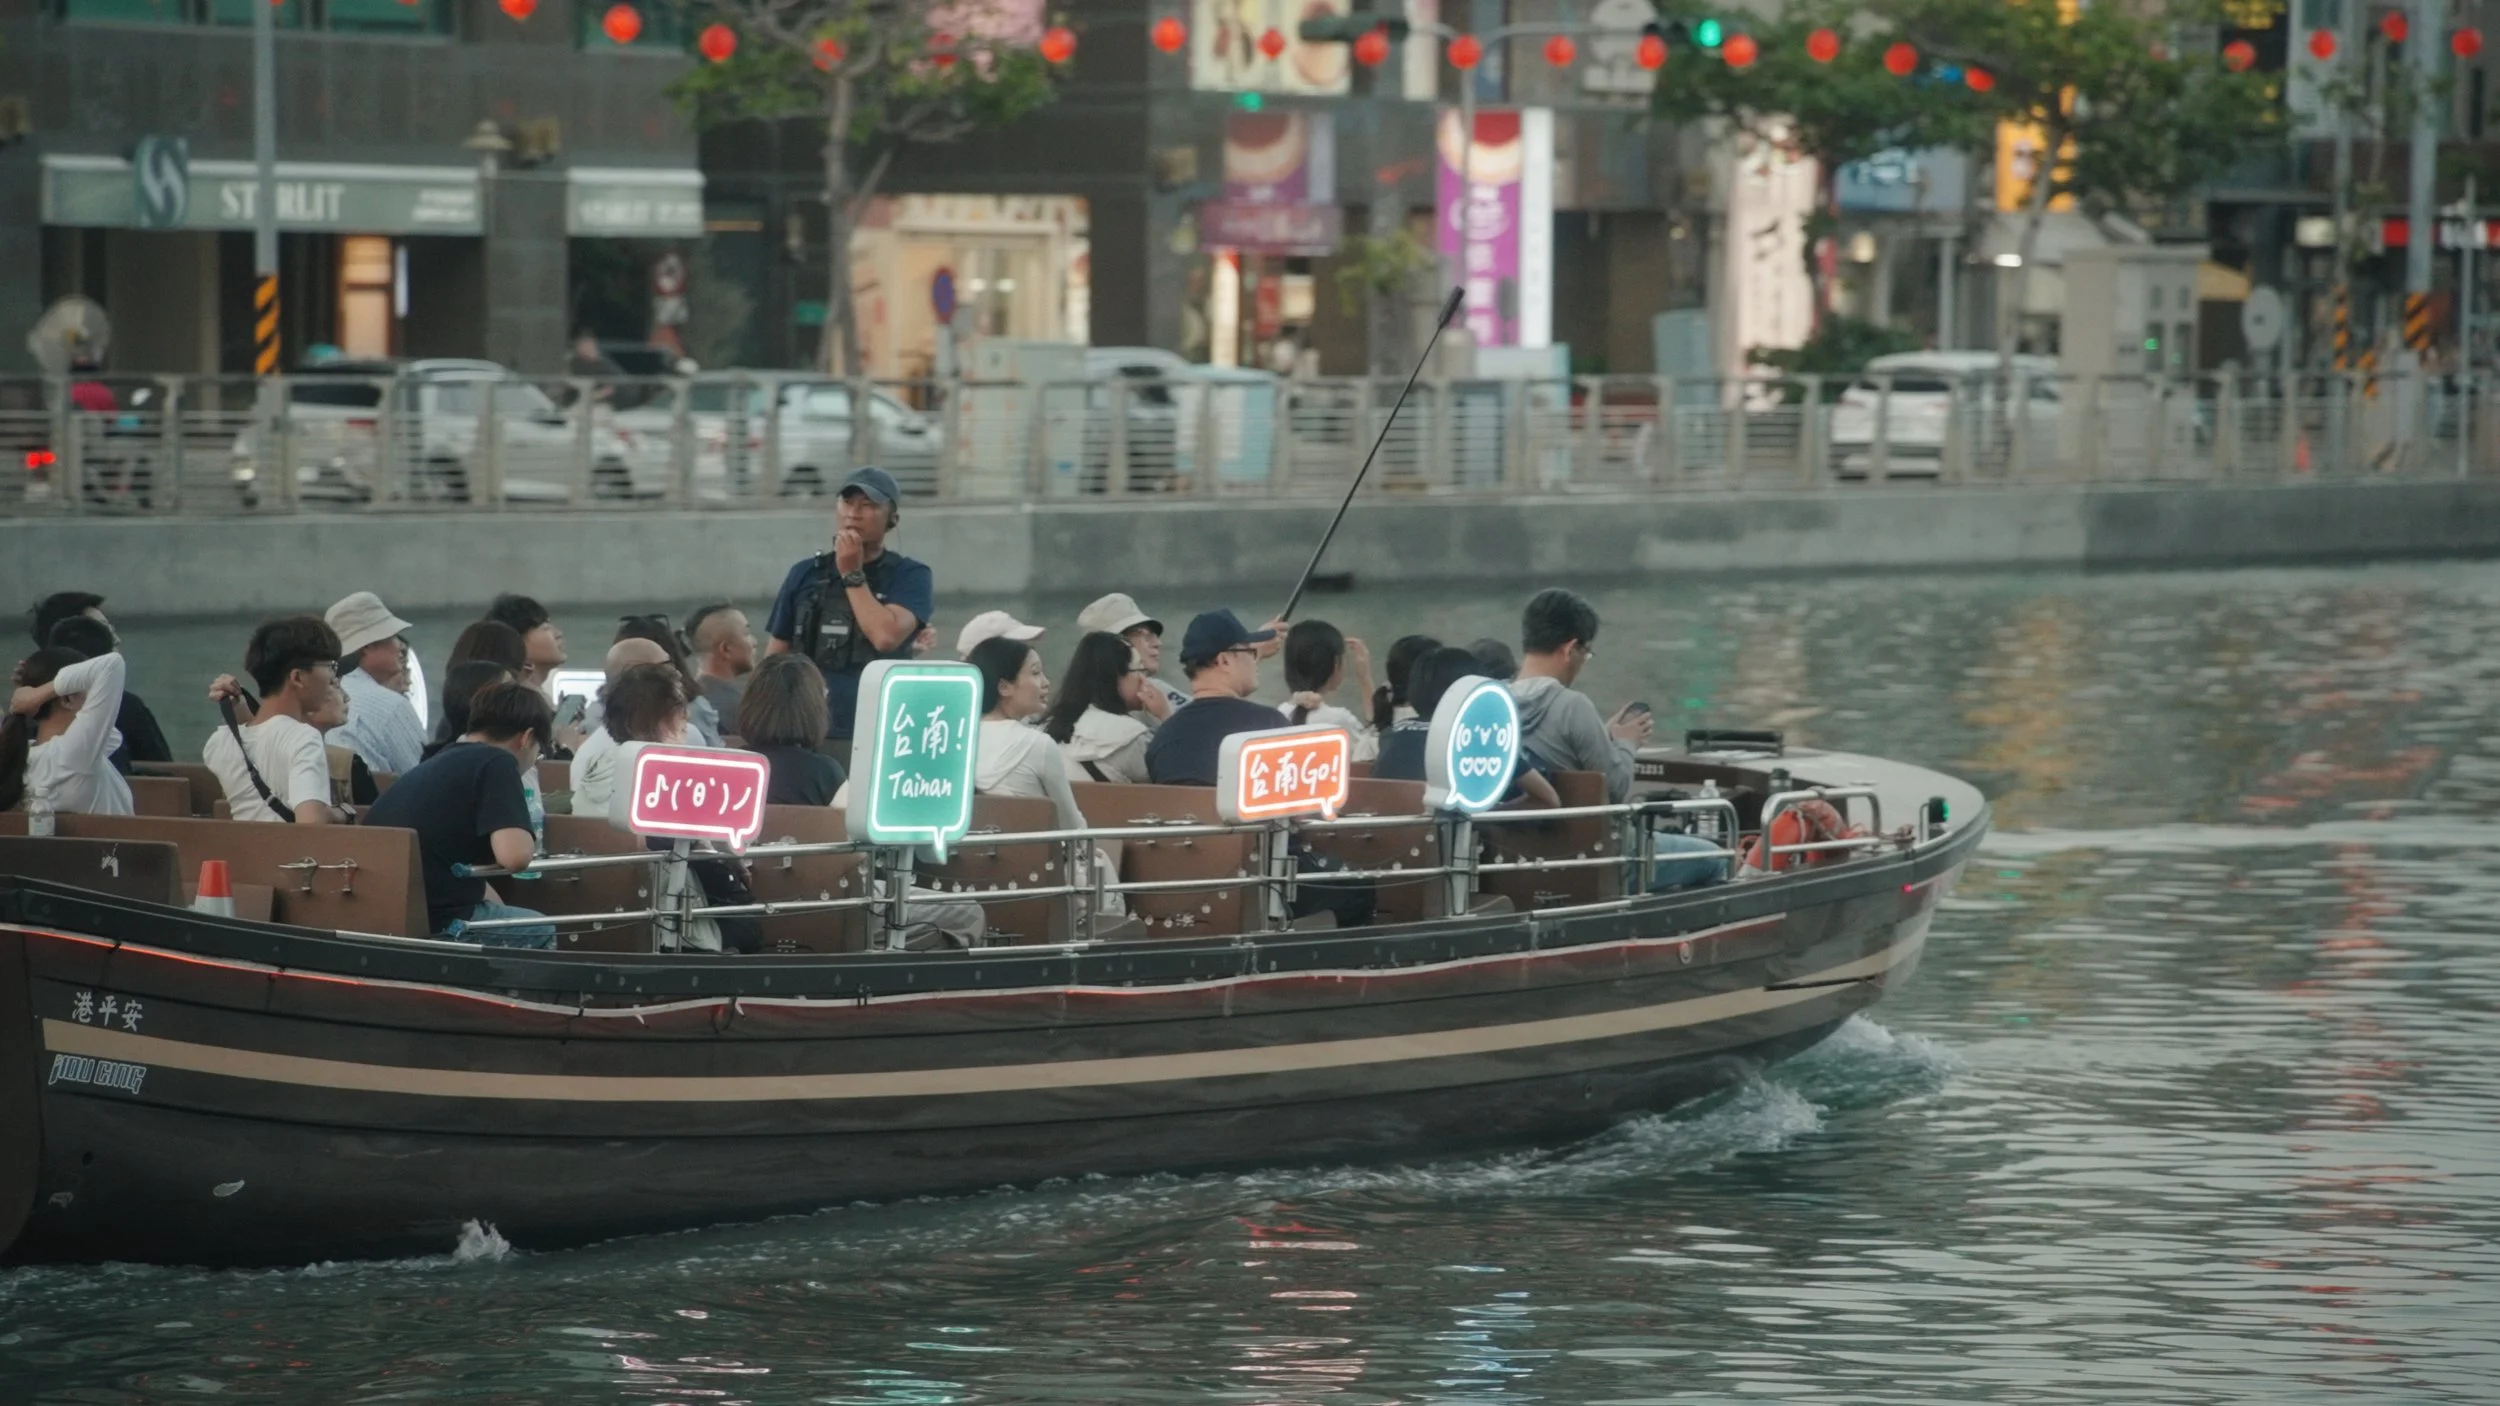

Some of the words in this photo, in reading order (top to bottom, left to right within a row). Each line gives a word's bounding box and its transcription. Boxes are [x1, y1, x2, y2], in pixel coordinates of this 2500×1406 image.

[220, 181, 346, 221] STRLIT
[893, 703, 966, 760] 台南!
[888, 770, 952, 800] Tainan
[1249, 750, 1340, 800] 台南Go!
